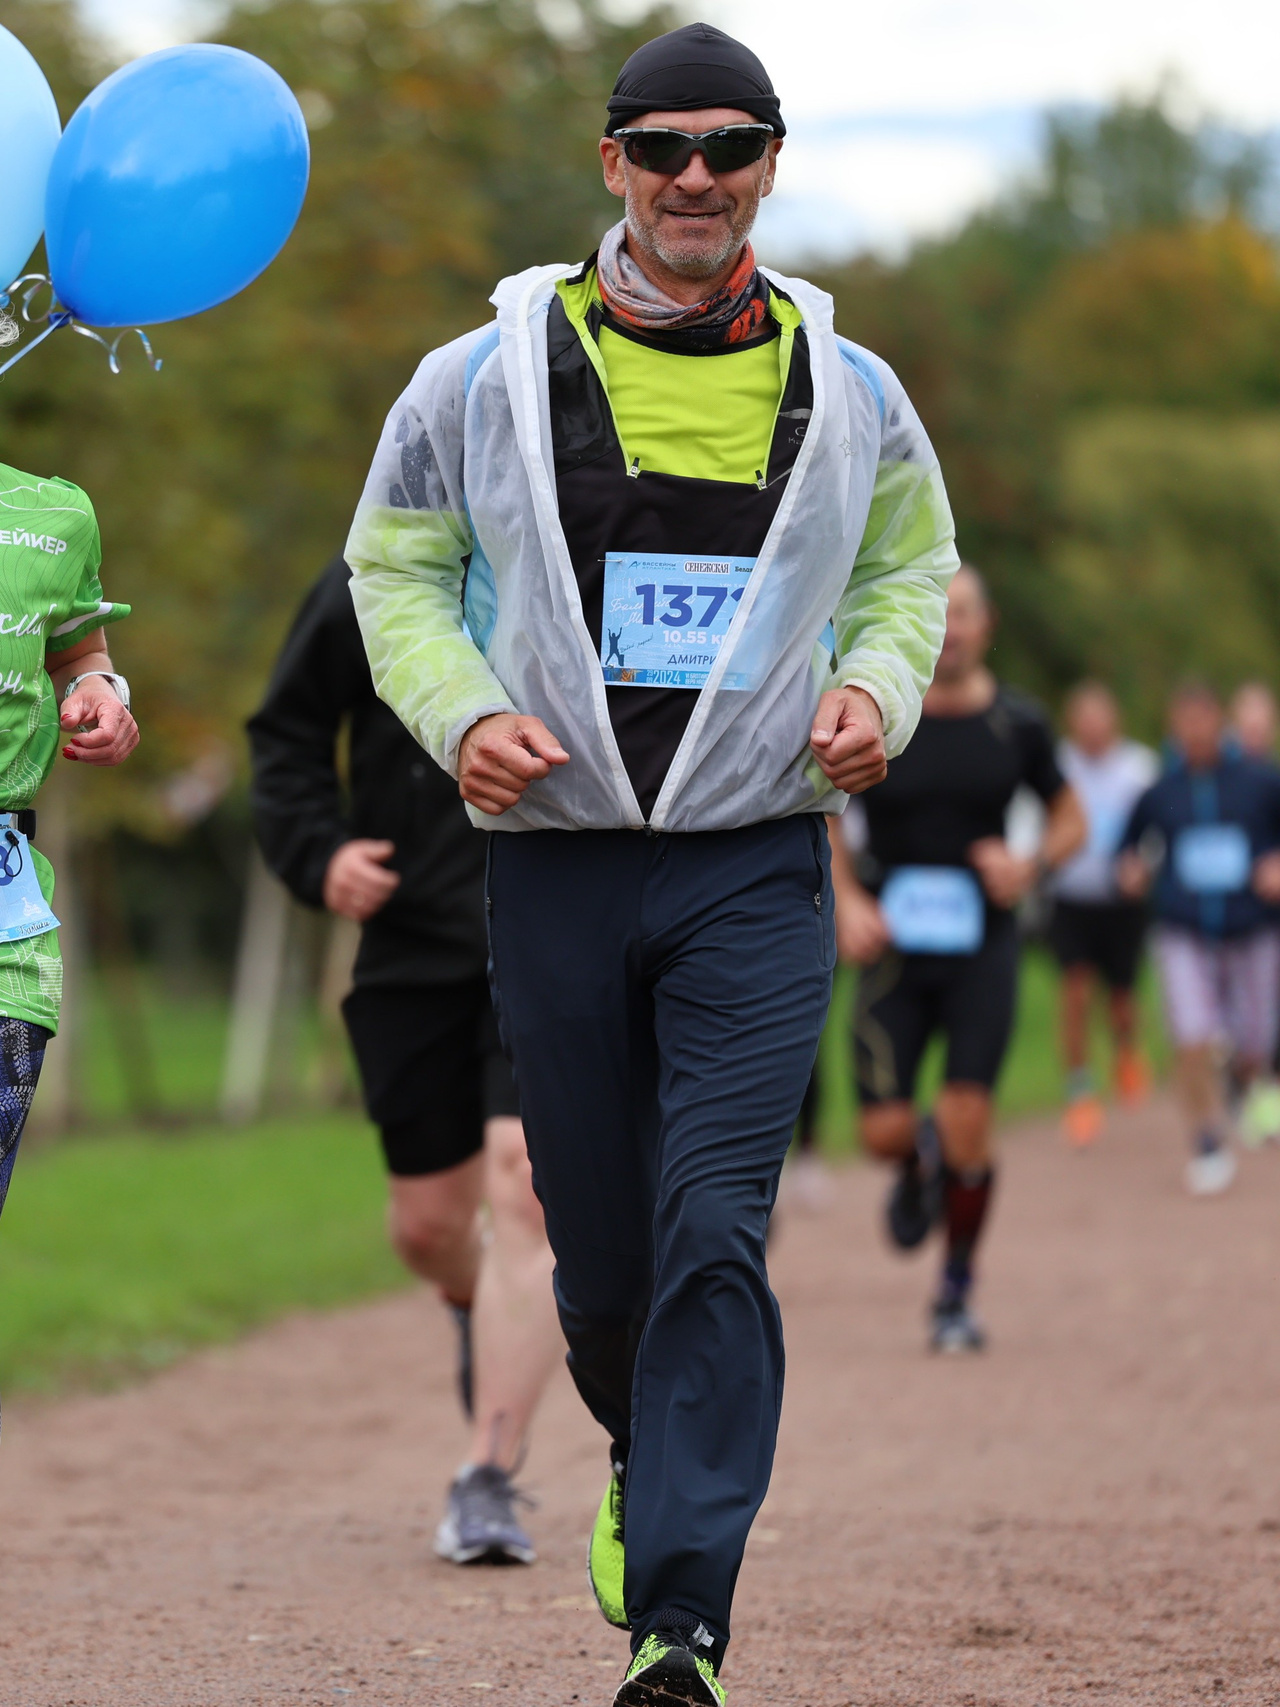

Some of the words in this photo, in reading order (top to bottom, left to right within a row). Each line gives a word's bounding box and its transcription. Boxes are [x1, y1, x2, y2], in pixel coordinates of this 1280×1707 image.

[685, 562, 729, 573] СЕНЕЖСКАЯ
[663, 630, 708, 645] 10.55
[667, 654, 717, 665] ДМИТРИ
[653, 670, 681, 685] 2024
